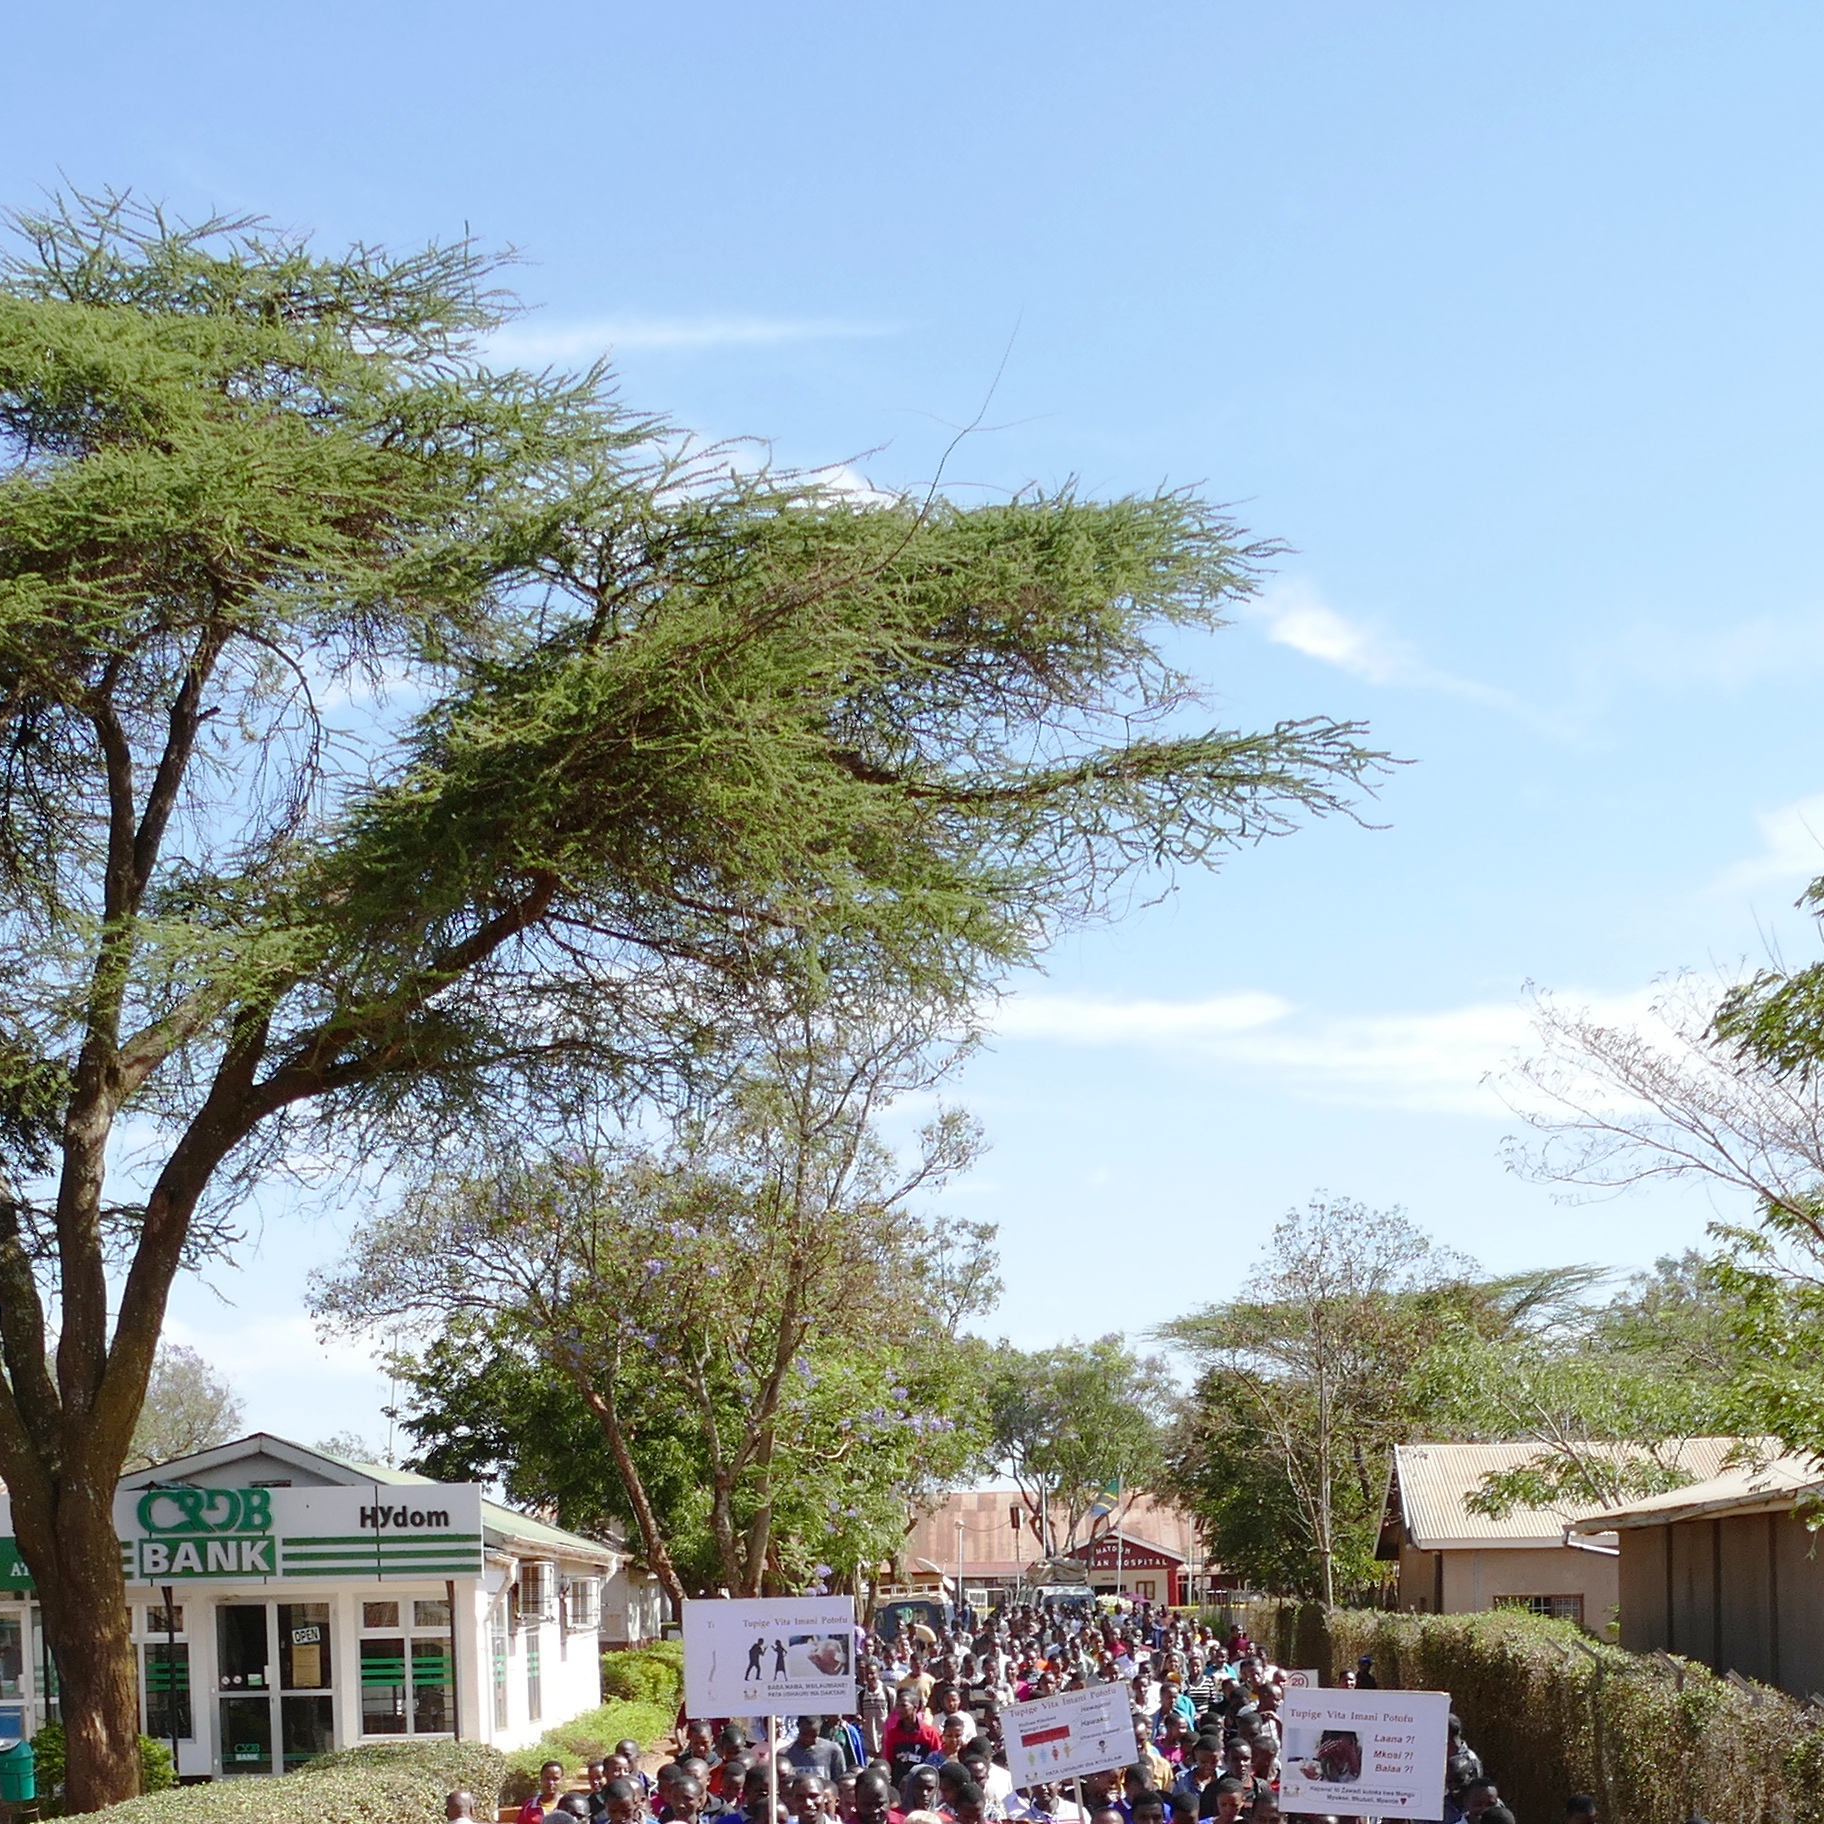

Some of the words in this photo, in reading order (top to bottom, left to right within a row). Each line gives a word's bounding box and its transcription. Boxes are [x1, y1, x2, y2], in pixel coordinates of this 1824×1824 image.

[360, 1504, 449, 1528] Hydom
[142, 1540, 271, 1574] BANK
[10, 1562, 29, 1576] AT
[743, 1619, 771, 1630] Tupige
[774, 1618, 790, 1626] Vita
[794, 1617, 817, 1626] Imani
[821, 1616, 848, 1625] Potofu
[294, 1627, 318, 1642] OPEN
[1291, 1678, 1304, 1687] 20
[1009, 1706, 1038, 1718] Tupige
[1042, 1702, 1059, 1711] Vita
[1063, 1695, 1086, 1706] Imani
[1090, 1688, 1116, 1699] Potofu
[1290, 1708, 1322, 1719] Tupige
[1327, 1710, 1346, 1720] Vita
[1351, 1711, 1378, 1721] Imani
[1383, 1713, 1414, 1723] Potofu
[1374, 1734, 1402, 1743] Laana
[1405, 1735, 1415, 1744] ?!
[236, 1753, 259, 1761] BANK
[1404, 1751, 1414, 1760] ?!
[1375, 1763, 1402, 1773] Balaa
[1404, 1765, 1414, 1773] ?!
